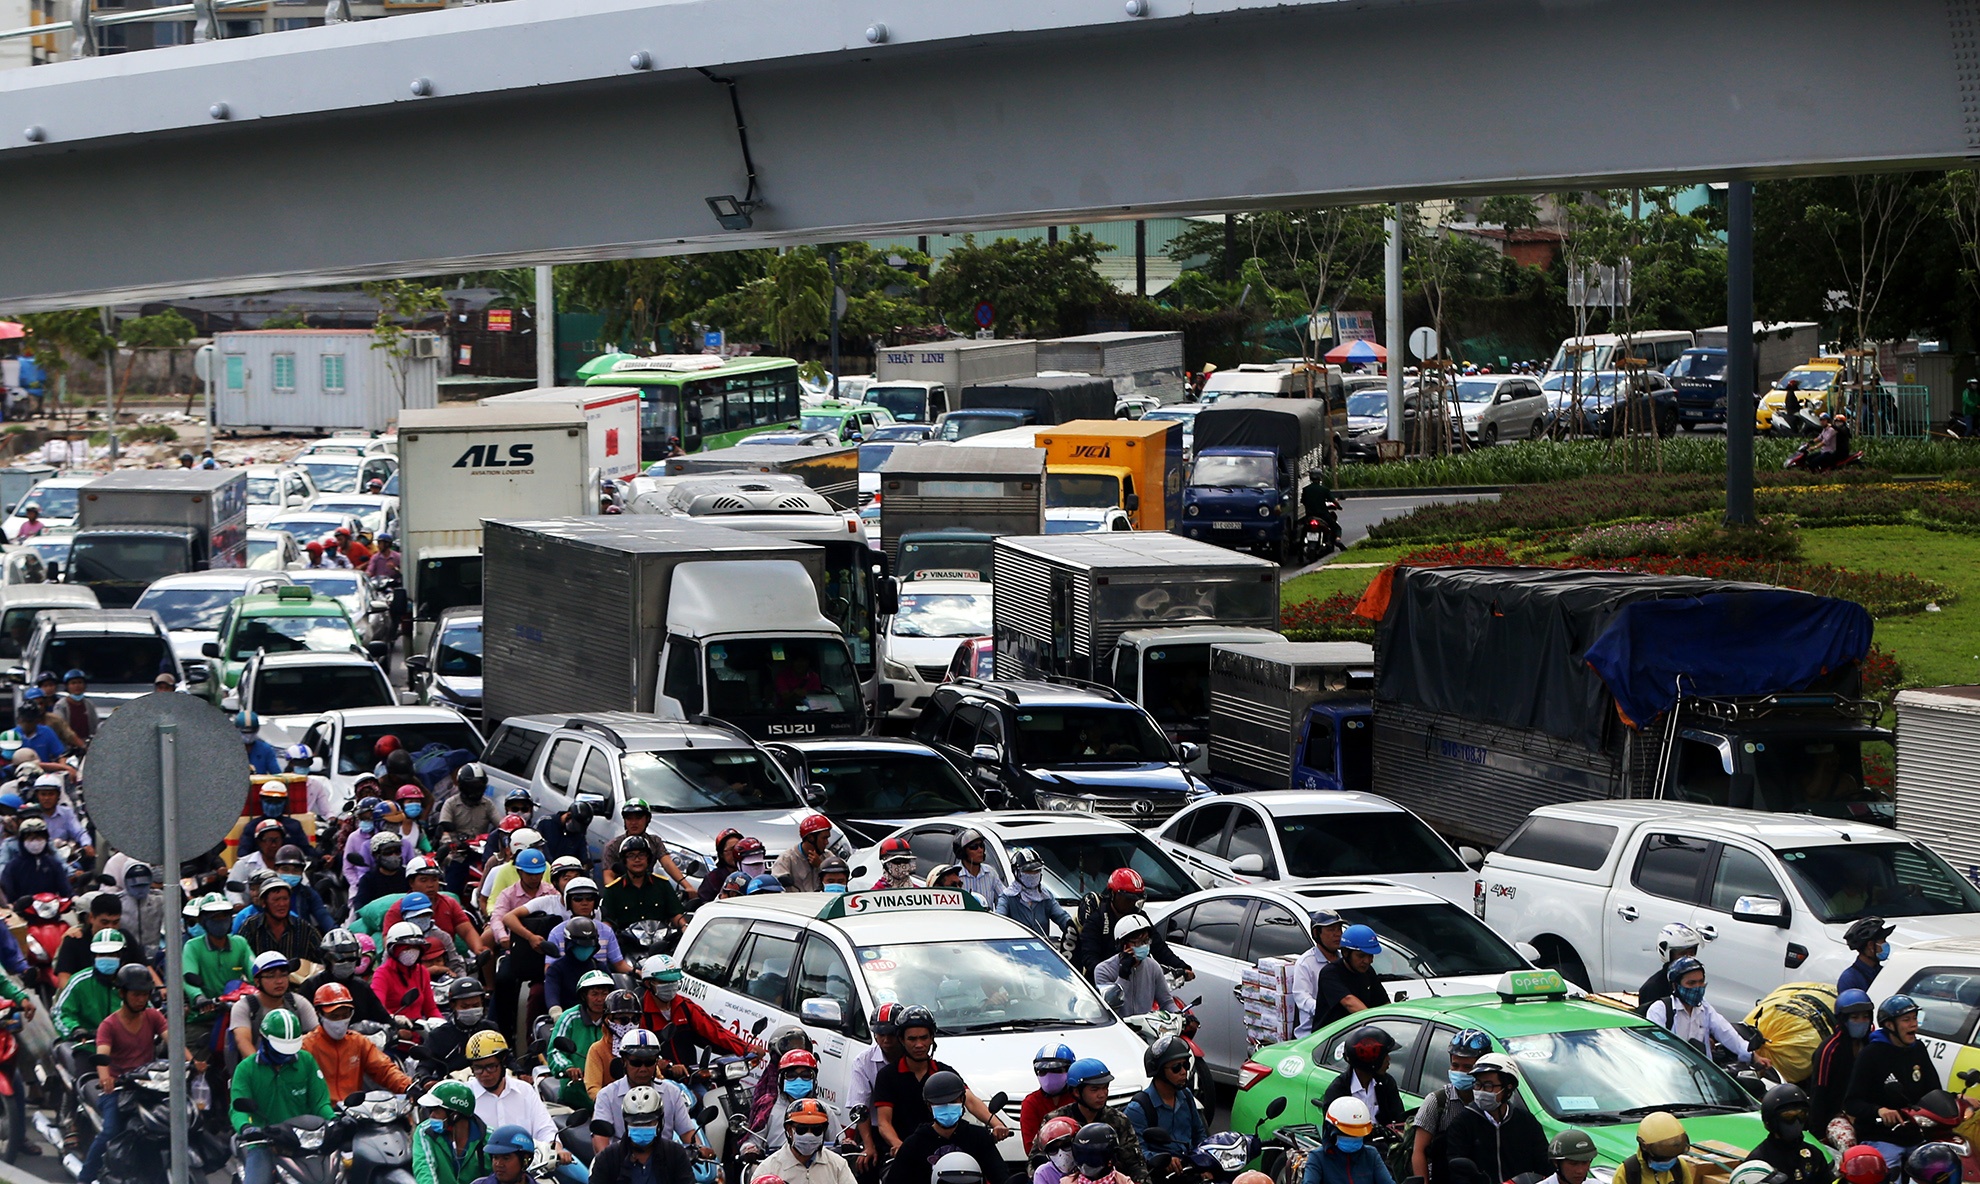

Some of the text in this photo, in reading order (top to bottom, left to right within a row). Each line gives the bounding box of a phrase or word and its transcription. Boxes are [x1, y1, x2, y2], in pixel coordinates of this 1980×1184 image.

[922, 353, 945, 363] LINH
[452, 444, 534, 468] ALS
[768, 724, 815, 734] ISUZU
[450, 1096, 470, 1108] Grab
